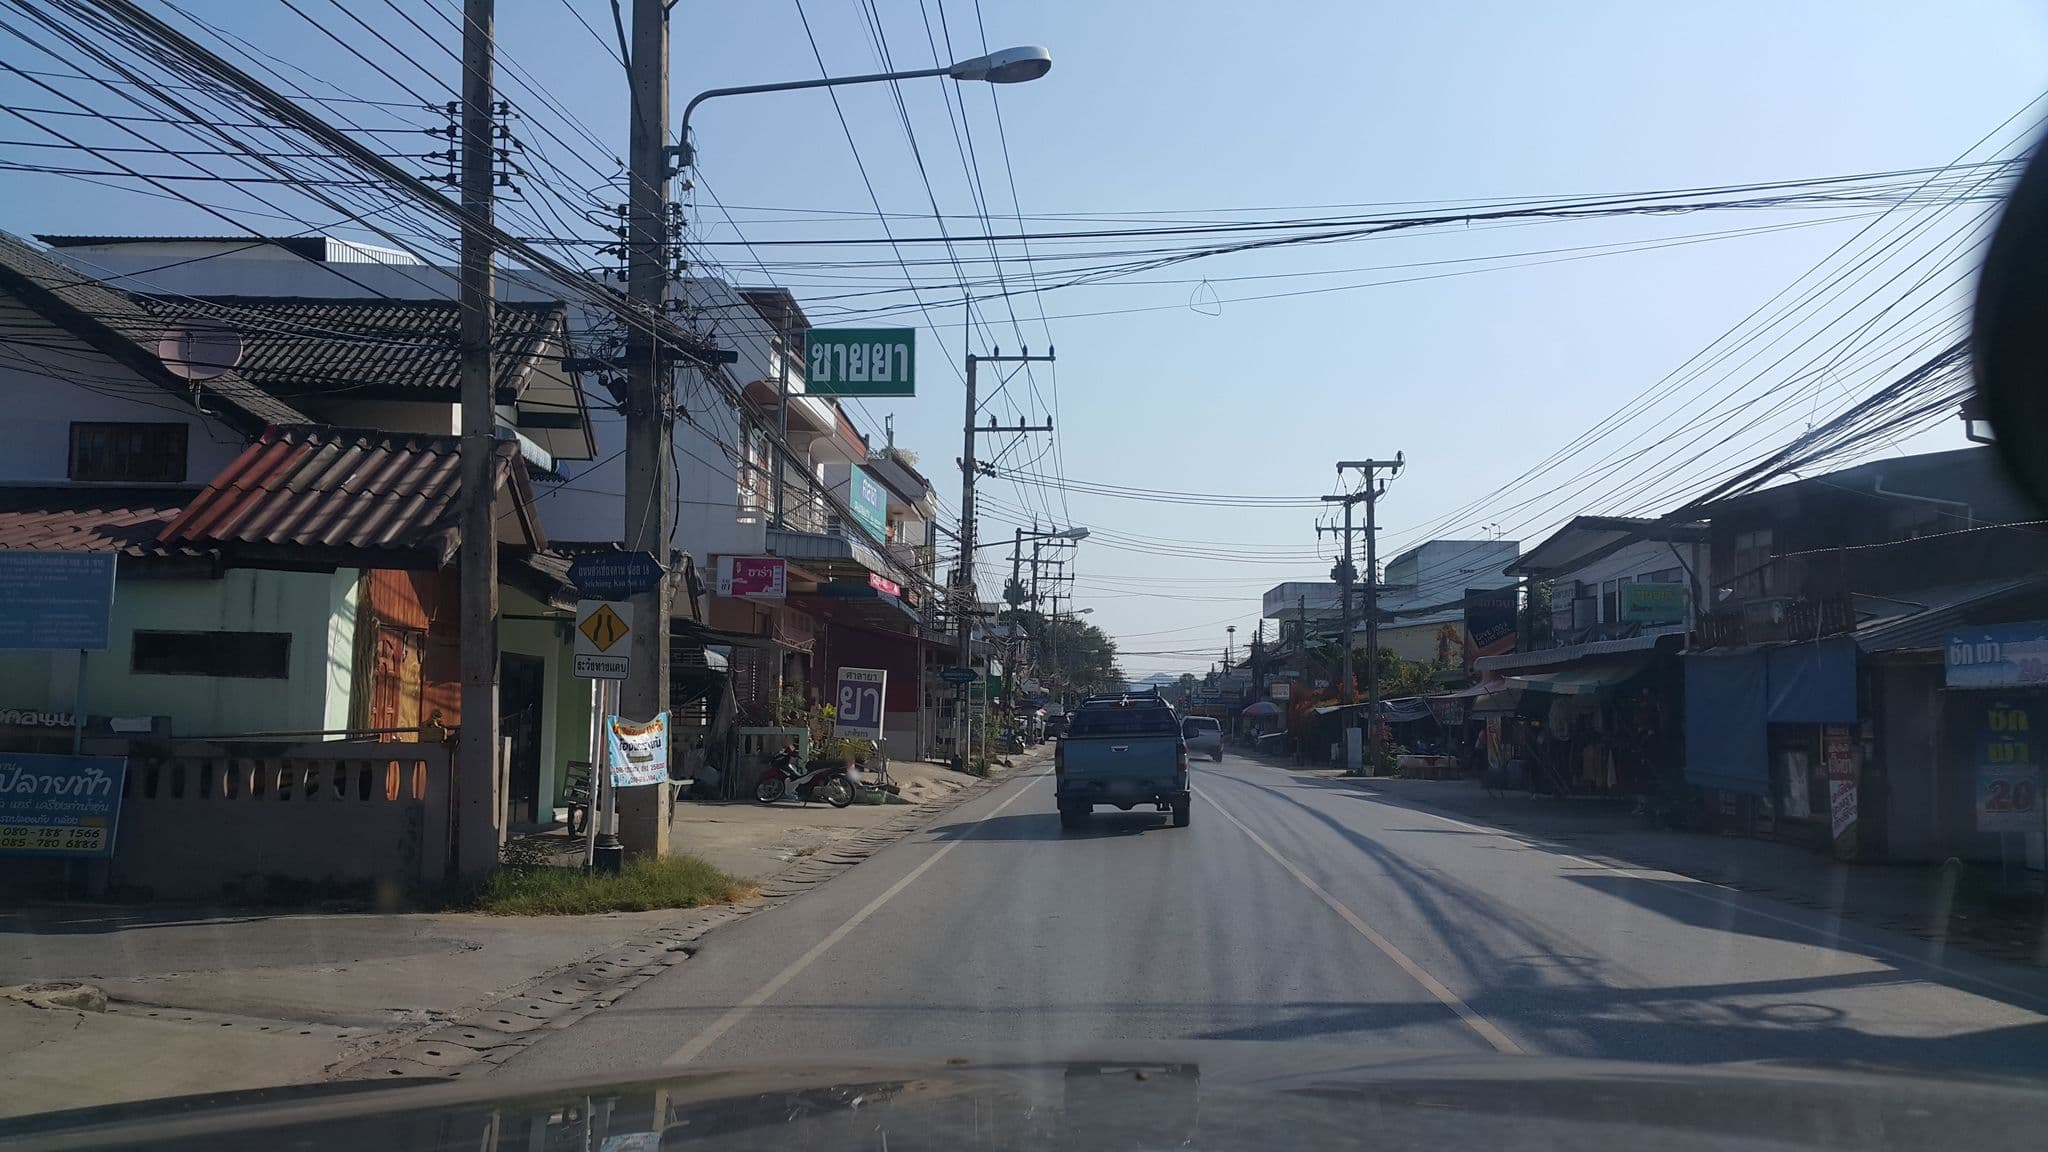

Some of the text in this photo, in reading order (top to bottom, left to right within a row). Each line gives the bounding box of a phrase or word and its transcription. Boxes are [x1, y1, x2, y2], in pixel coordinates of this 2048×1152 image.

[811, 343, 909, 382] ขายยา
[577, 657, 627, 673] ระวังทางแคบ
[840, 686, 879, 723] ยา
[1984, 779, 2033, 814] 20
[66, 839, 98, 849] 6886
[70, 828, 101, 838] 1566
